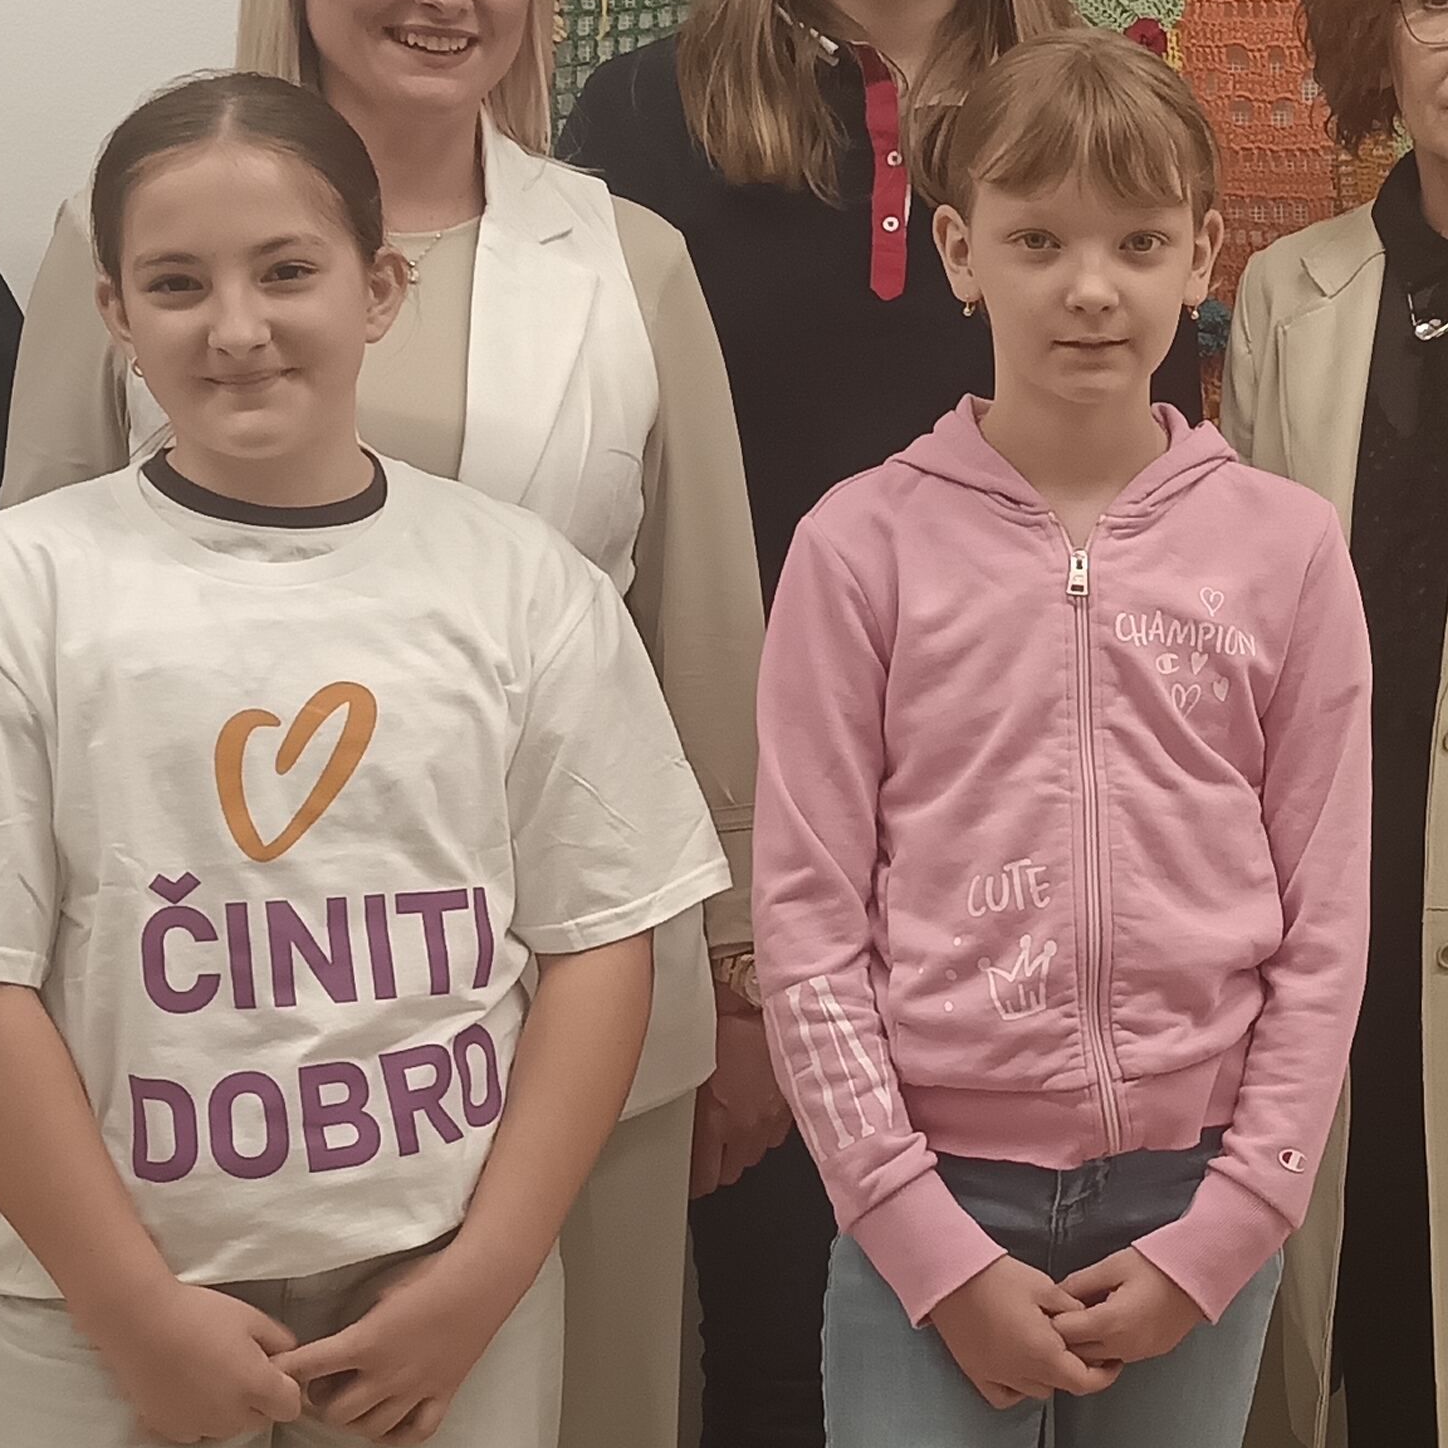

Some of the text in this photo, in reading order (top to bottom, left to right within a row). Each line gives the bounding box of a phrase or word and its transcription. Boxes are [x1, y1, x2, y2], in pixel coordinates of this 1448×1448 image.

[1115, 609, 1257, 657] CHAMPION
[967, 858, 1051, 918] CUTE
[141, 870, 496, 1015] ČINITI
[127, 1022, 503, 1184] DOBRO
